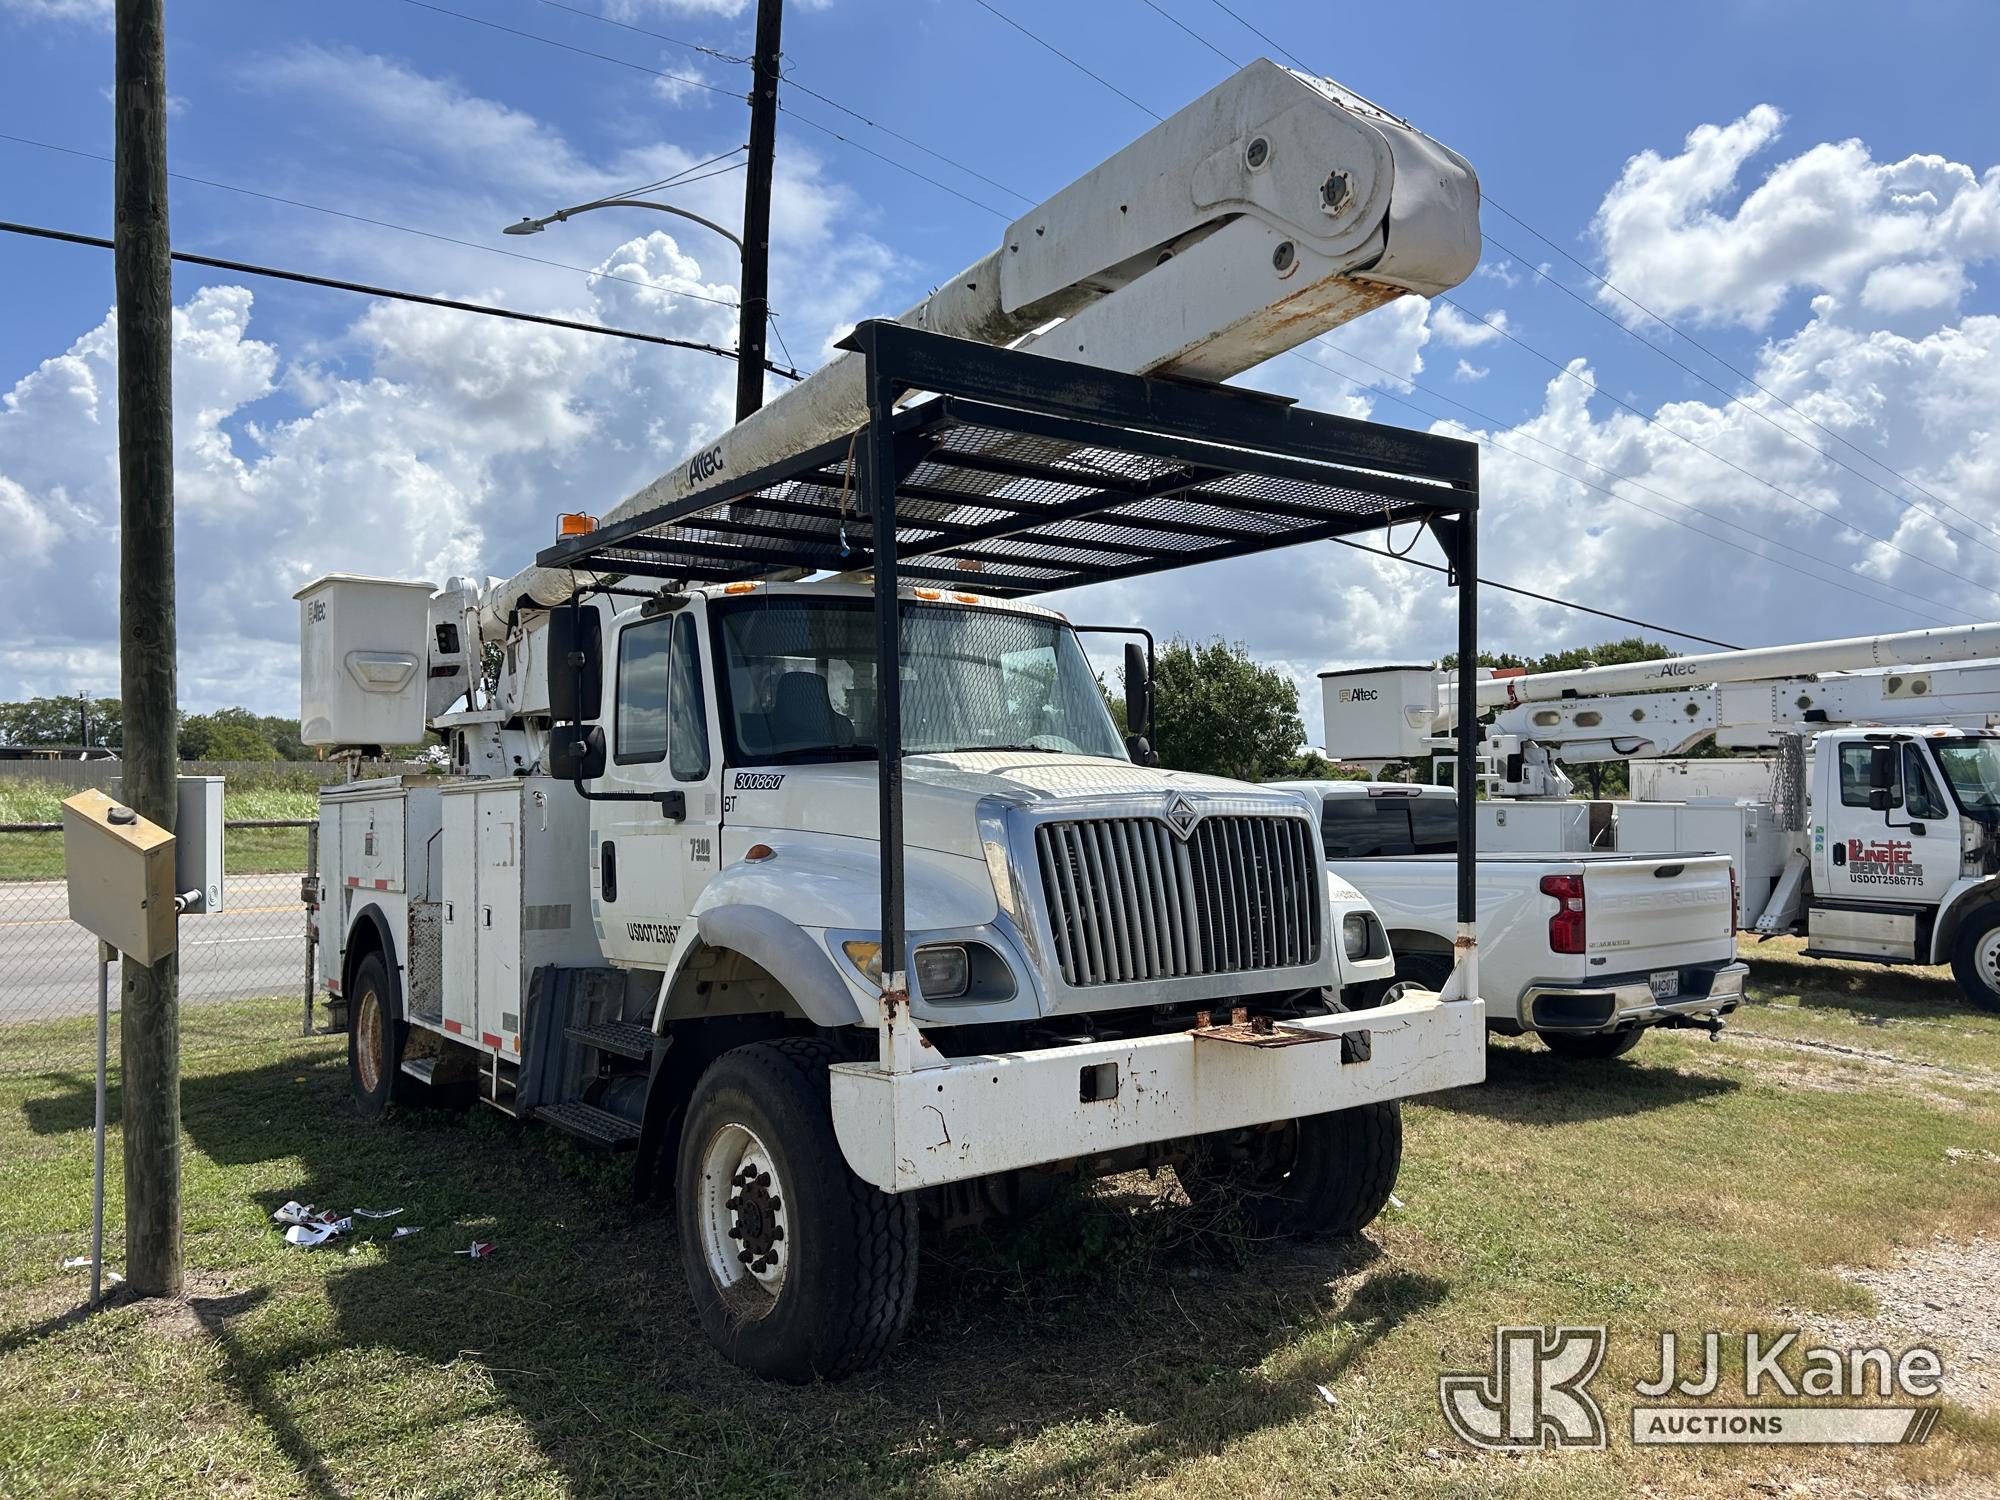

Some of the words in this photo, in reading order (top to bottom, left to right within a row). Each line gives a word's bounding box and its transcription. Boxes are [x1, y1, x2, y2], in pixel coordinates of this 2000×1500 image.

[690, 446, 724, 488] Altec
[1660, 662, 1697, 678] Altec
[1351, 687, 1378, 702] Altec
[736, 773, 782, 789] 300860
[724, 795, 737, 812] BT
[690, 838, 710, 861] 7300
[1849, 861, 1924, 876] SERVICES
[1850, 874, 1924, 886] USDOT2586775
